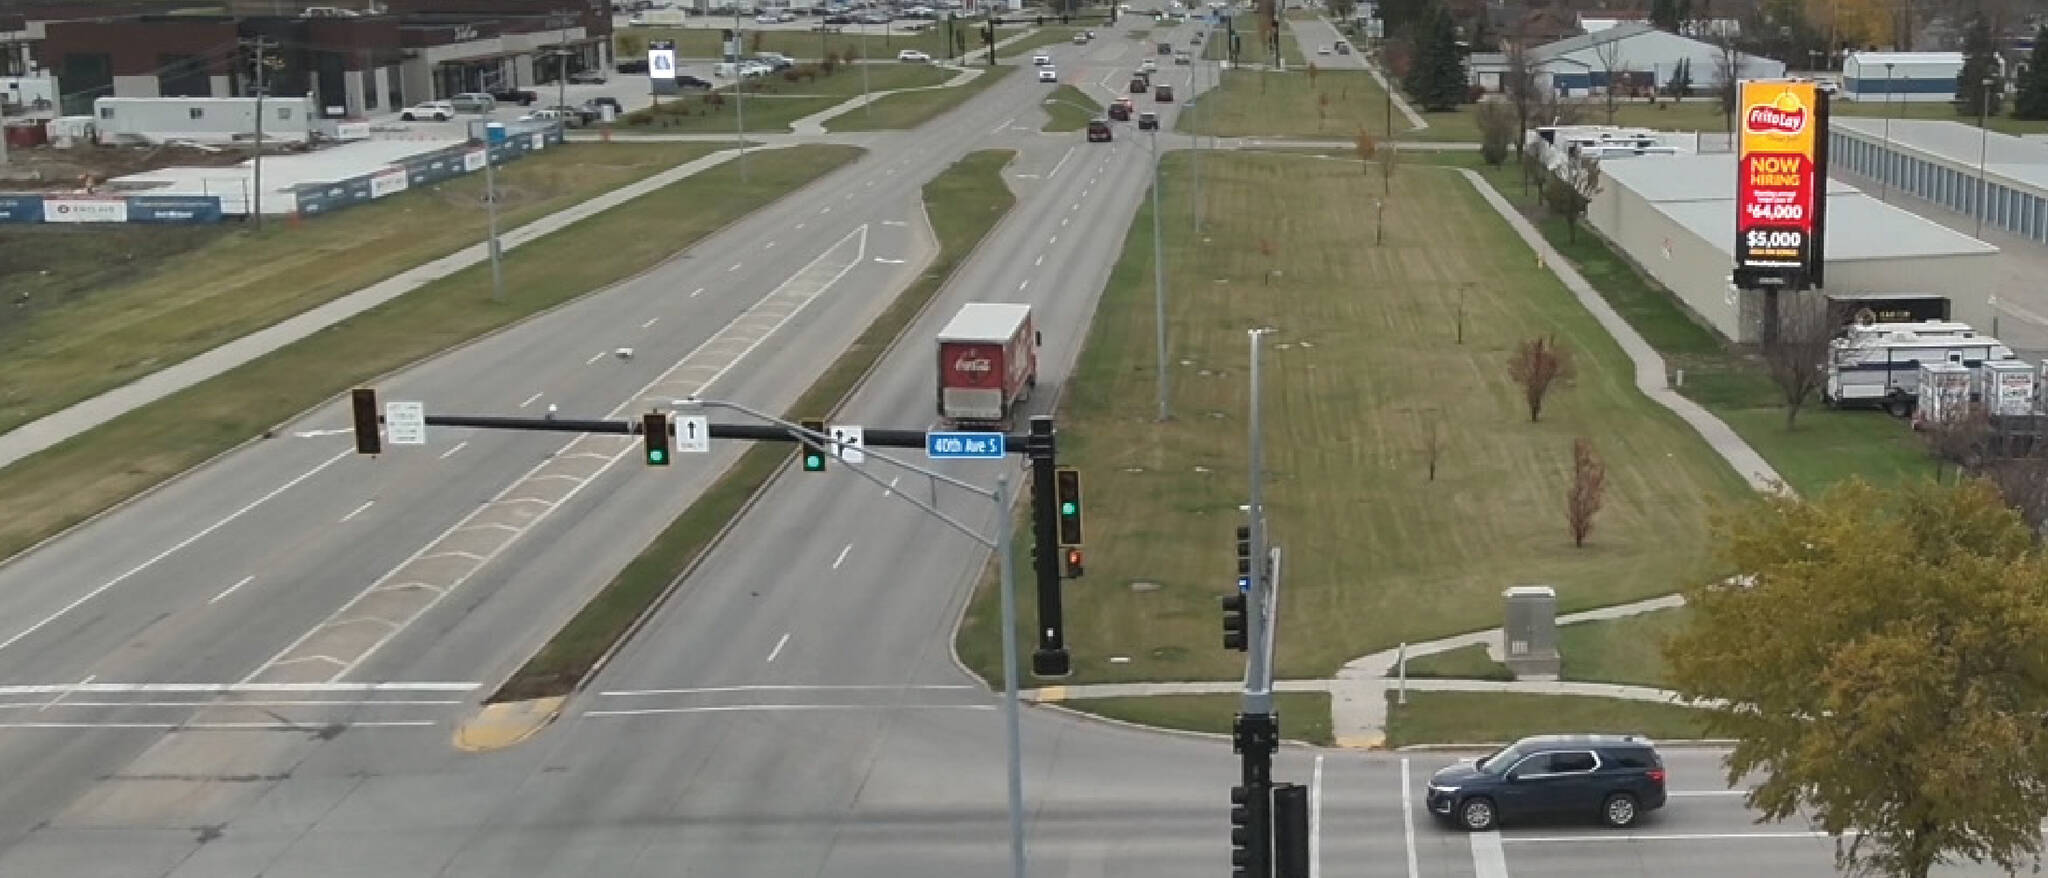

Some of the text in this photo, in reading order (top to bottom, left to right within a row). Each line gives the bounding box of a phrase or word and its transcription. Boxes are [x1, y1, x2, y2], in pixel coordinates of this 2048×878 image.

[1750, 157, 1800, 172] NOW
[1750, 174, 1800, 185] HIRING
[1746, 203, 1802, 219] $64,000
[1746, 229, 1800, 248] $5,000
[935, 438, 998, 452] 40th Ave S
